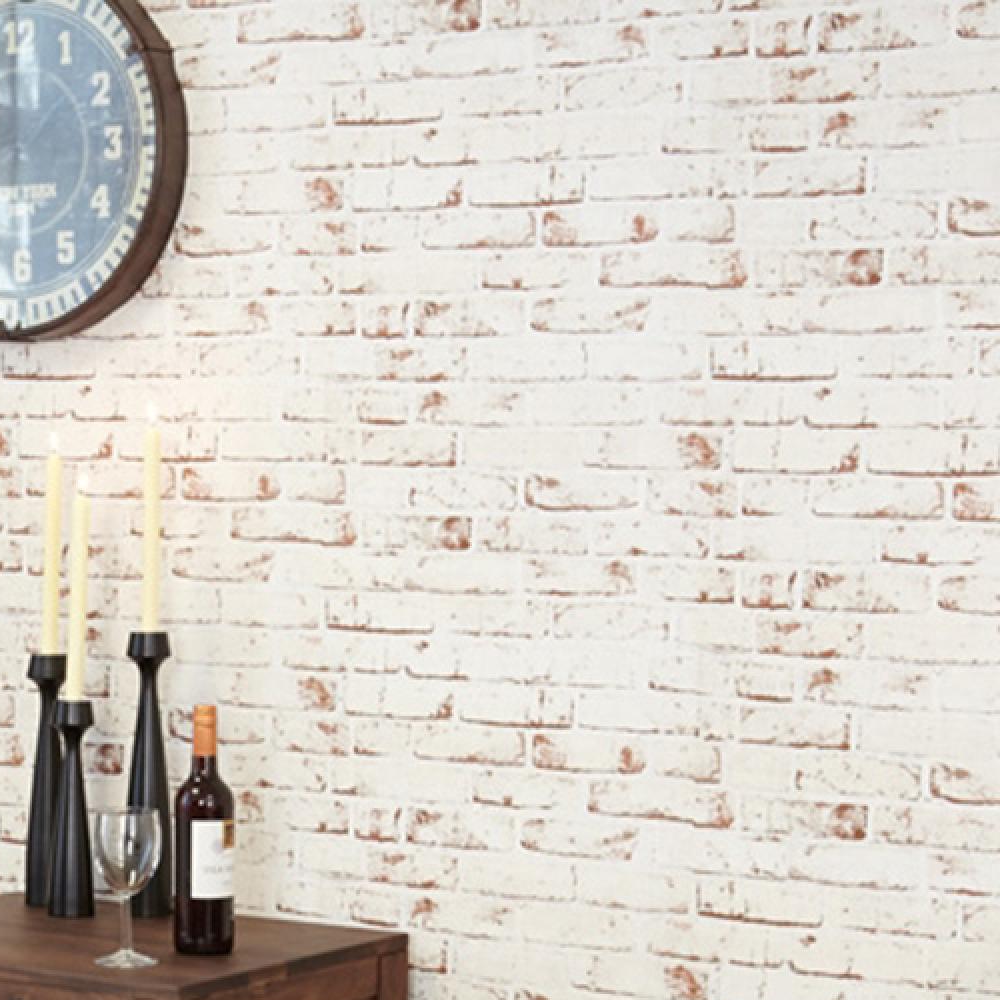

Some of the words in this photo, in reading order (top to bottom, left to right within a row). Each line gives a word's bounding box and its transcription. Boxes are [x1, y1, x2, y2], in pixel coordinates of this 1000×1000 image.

[3, 18, 36, 54] 12
[58, 31, 71, 65] 1
[90, 71, 111, 107] 2
[104, 124, 123, 159] 3
[90, 183, 111, 218] 4
[56, 230, 75, 264] 5
[13, 248, 32, 283] 6
